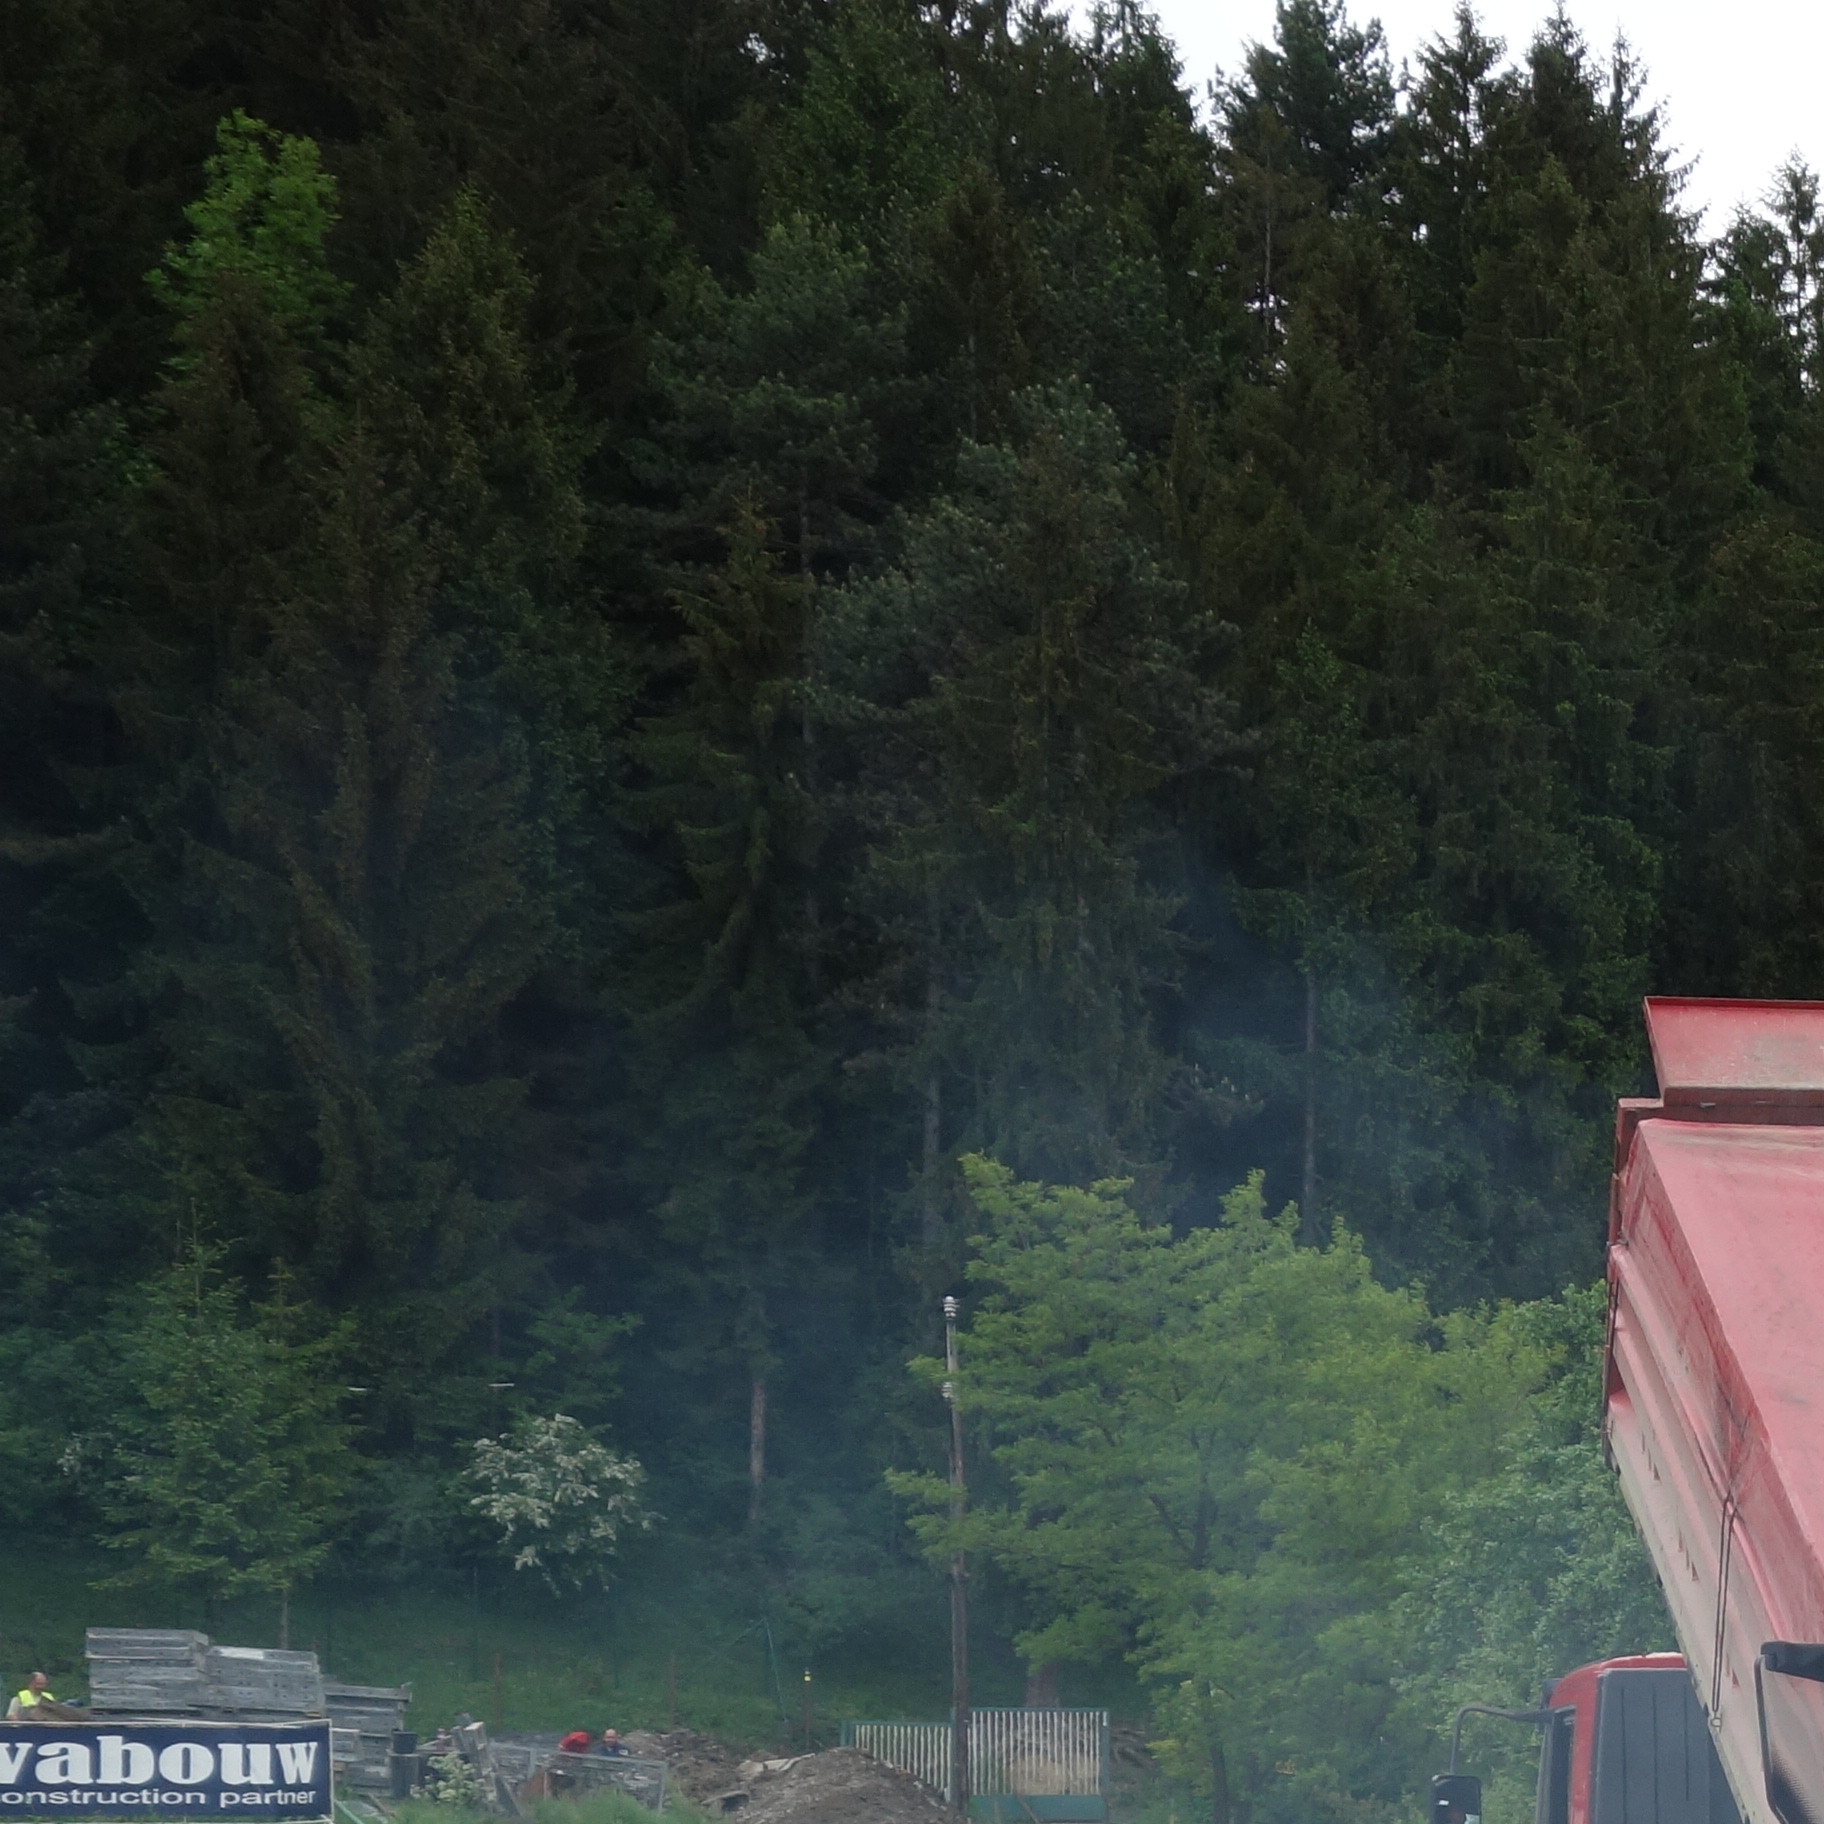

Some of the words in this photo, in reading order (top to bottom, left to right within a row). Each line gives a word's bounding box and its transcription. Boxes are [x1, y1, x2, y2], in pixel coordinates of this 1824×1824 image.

[0, 1735, 318, 1785] vabouw
[1, 1788, 206, 1805] onstruction
[220, 1789, 316, 1808] partner
